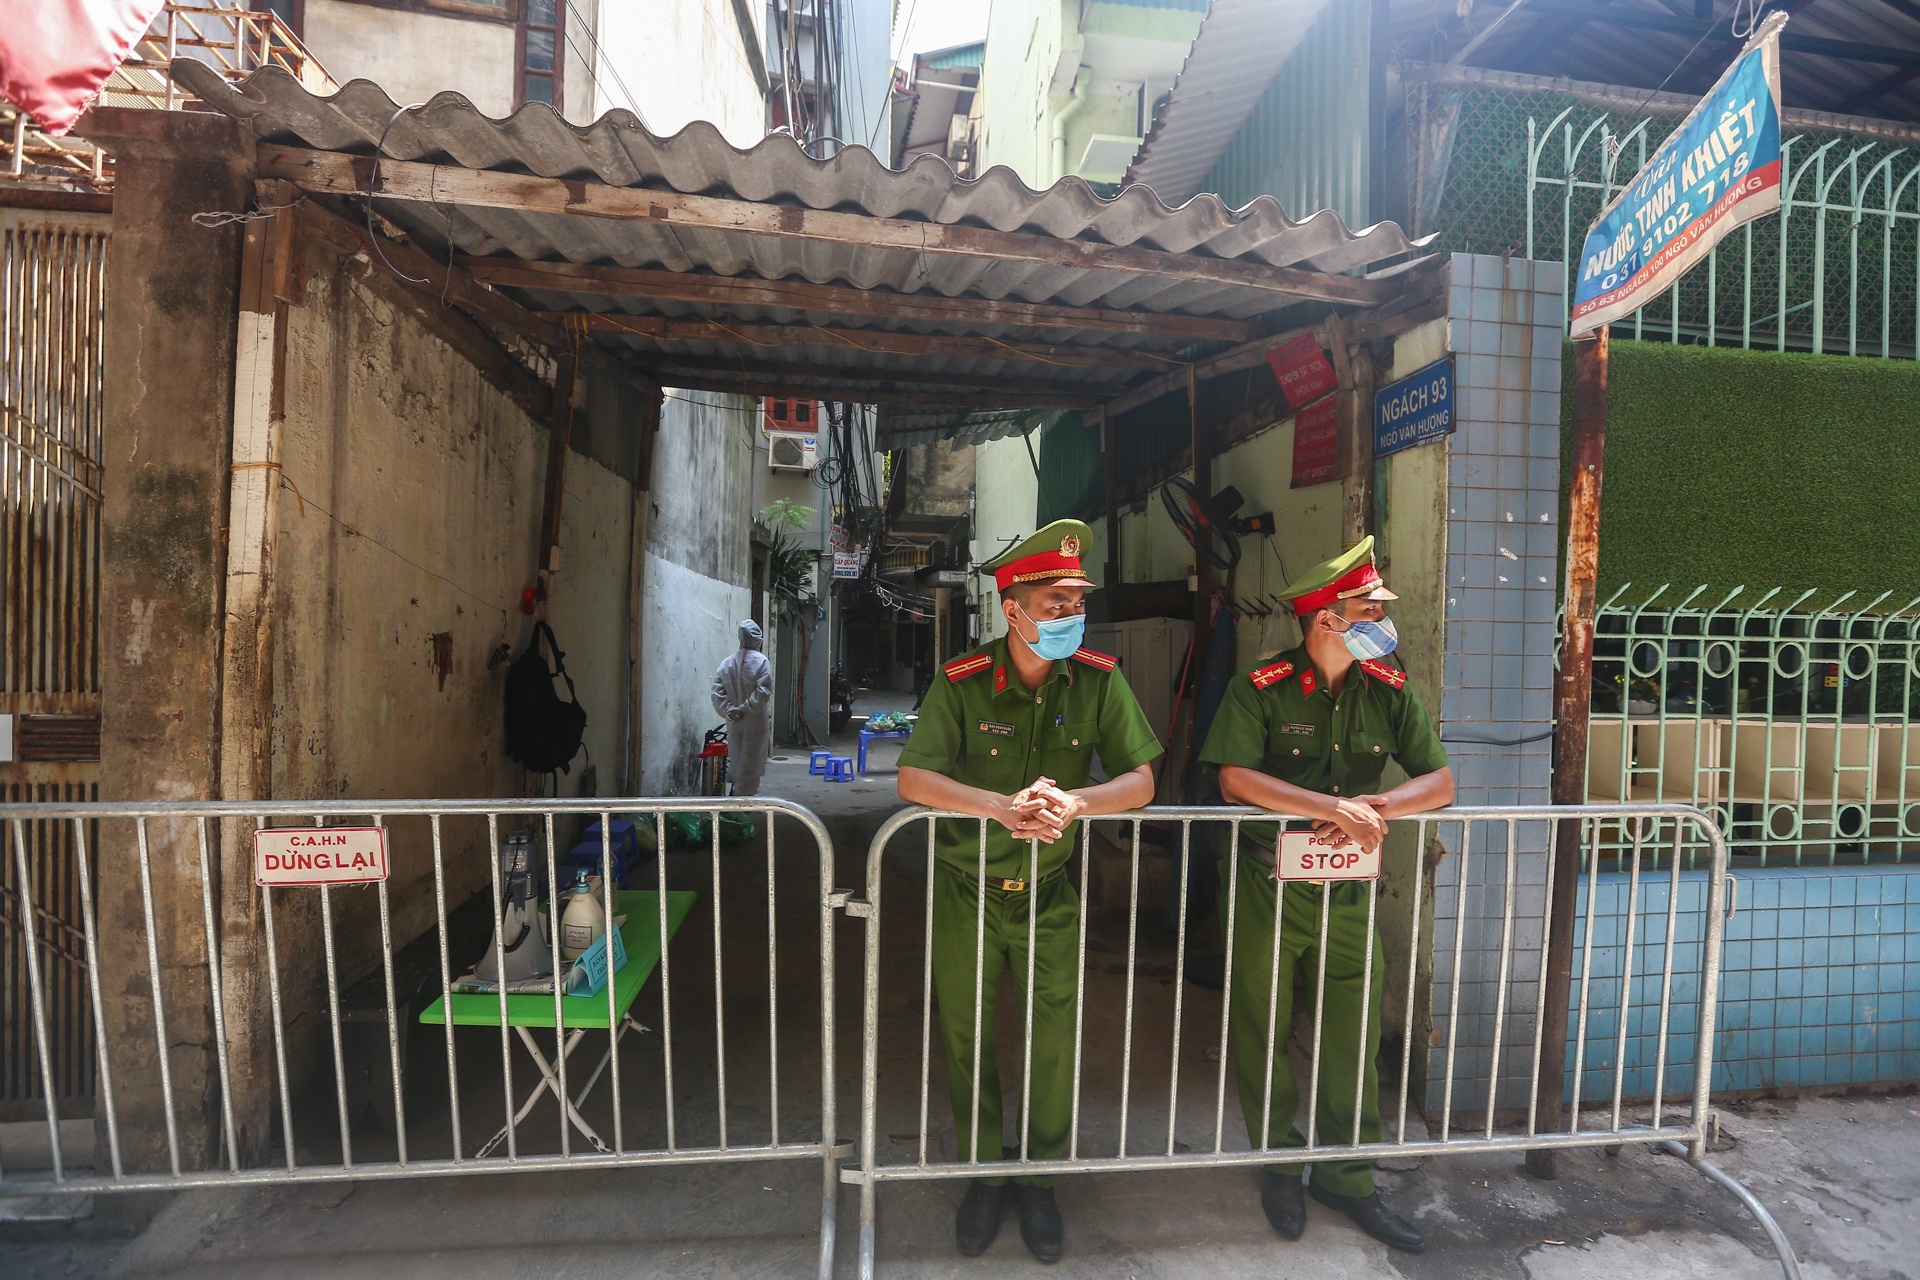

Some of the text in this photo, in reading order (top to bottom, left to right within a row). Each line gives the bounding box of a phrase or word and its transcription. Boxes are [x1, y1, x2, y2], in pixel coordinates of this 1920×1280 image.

[1584, 98, 1756, 280] NƯỚC TINH KHIẾT
[1602, 152, 1749, 290] 037 9102 718
[1580, 176, 1762, 314] SỐ 63 NGÁCH 100 NGÕ VĂN HƯƠNG
[1382, 377, 1447, 425] NGÁCH 93
[1400, 422, 1416, 441] VĂN
[1418, 410, 1449, 435] HƯƠNG
[290, 835, 347, 846] C.A.H.N
[1309, 837, 1353, 846] POIC
[265, 849, 376, 871] DỪNG LẠI
[1300, 853, 1360, 870] STOP
